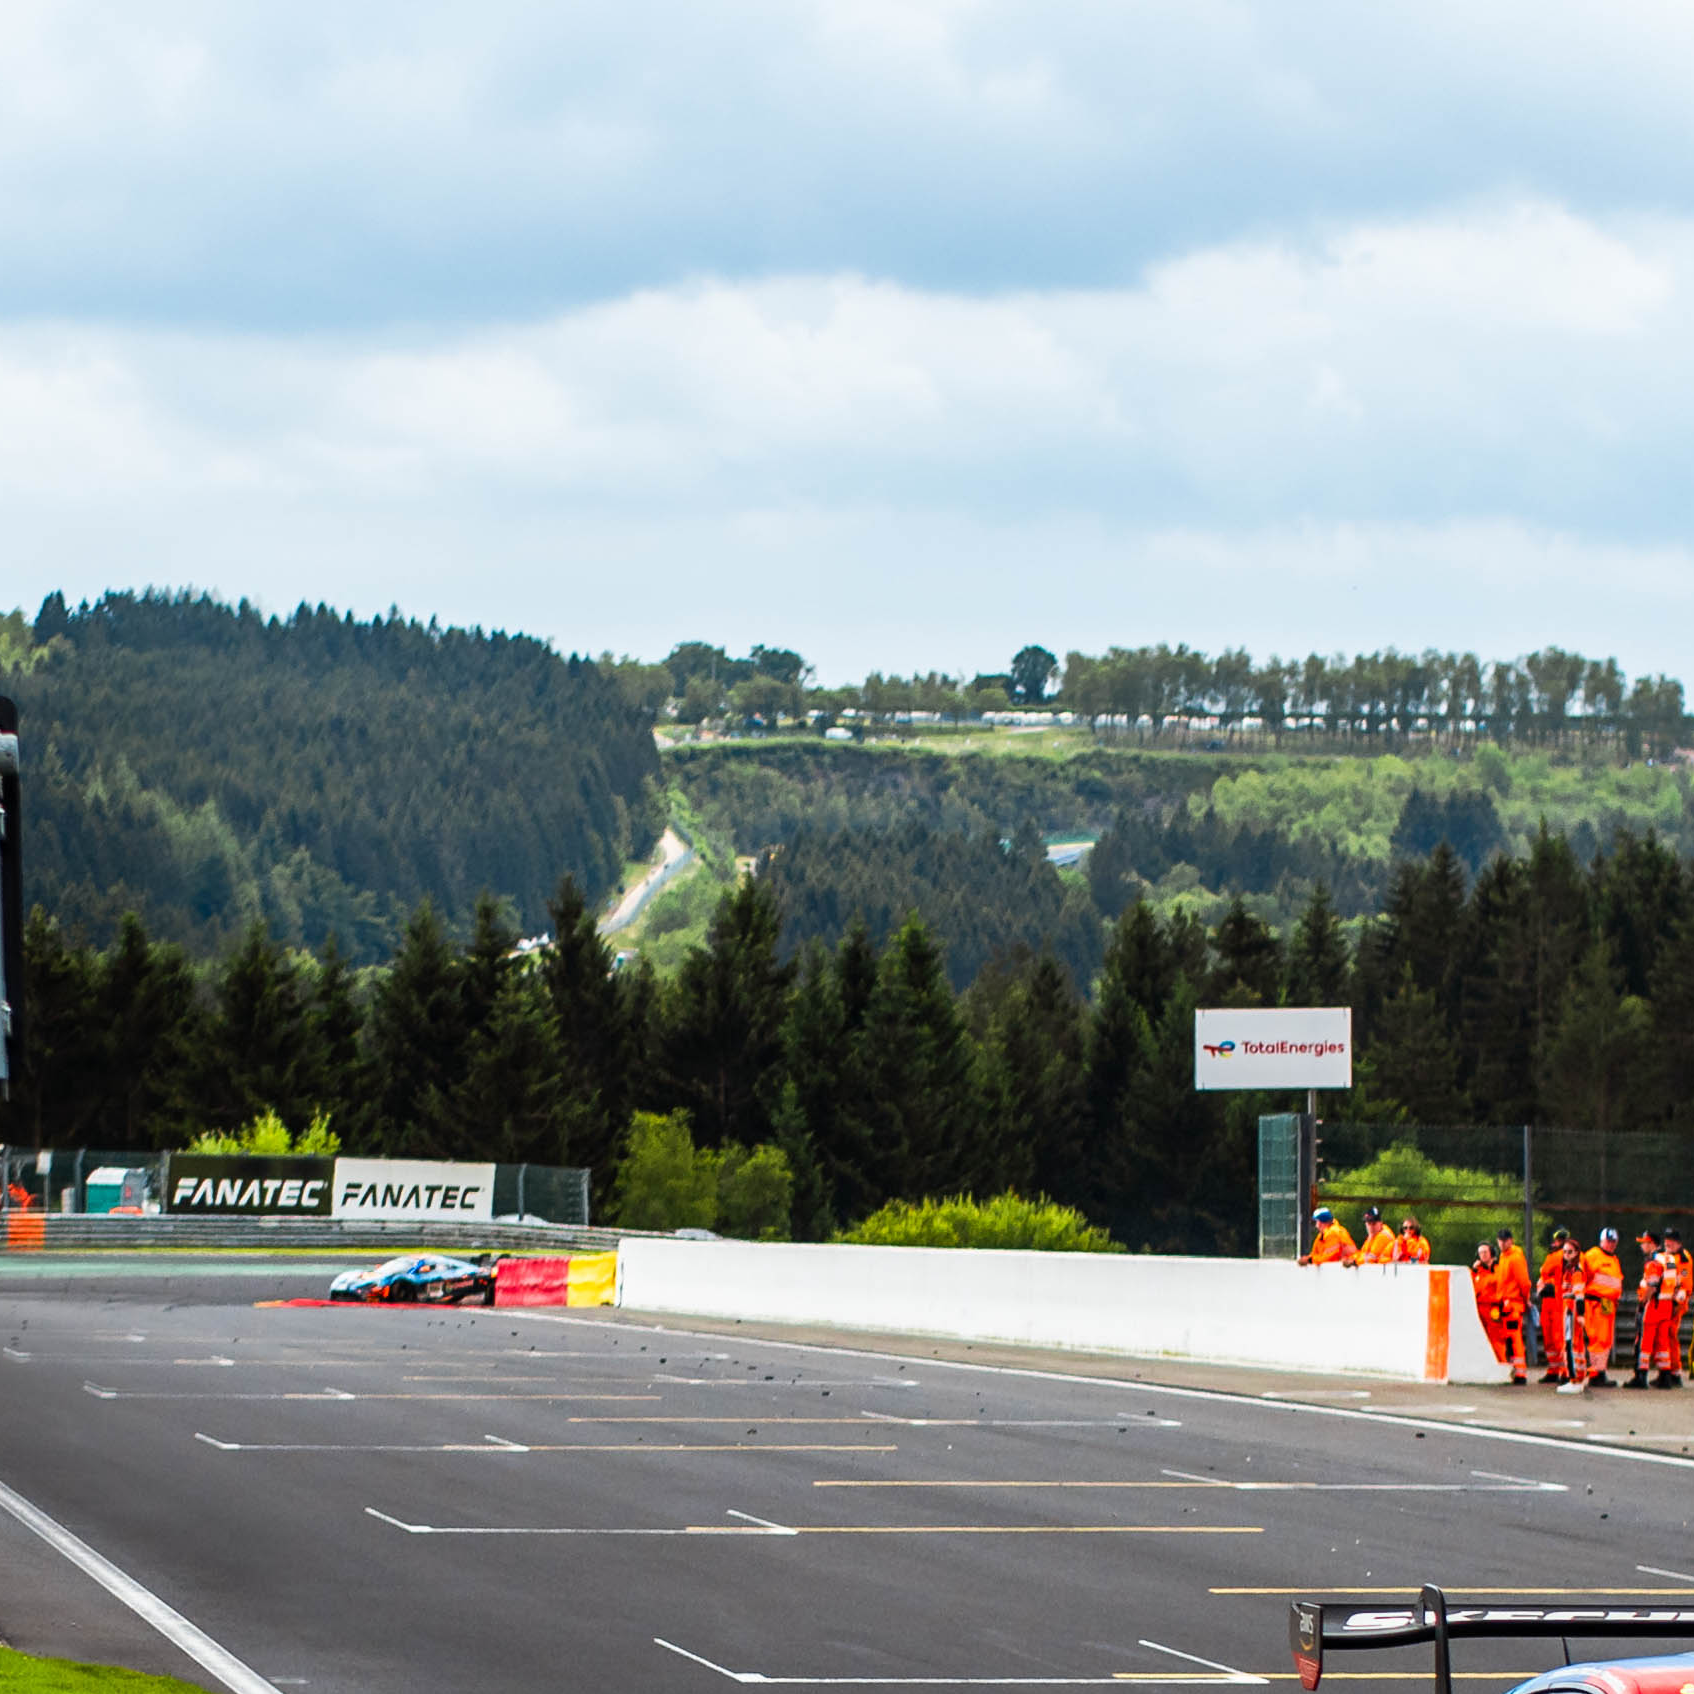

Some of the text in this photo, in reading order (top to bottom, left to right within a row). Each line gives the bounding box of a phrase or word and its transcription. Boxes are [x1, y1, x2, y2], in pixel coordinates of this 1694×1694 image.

[1241, 1040, 1345, 1058] TotalEnergies
[173, 1176, 325, 1208] FANATEC
[341, 1182, 480, 1210] FANATEC
